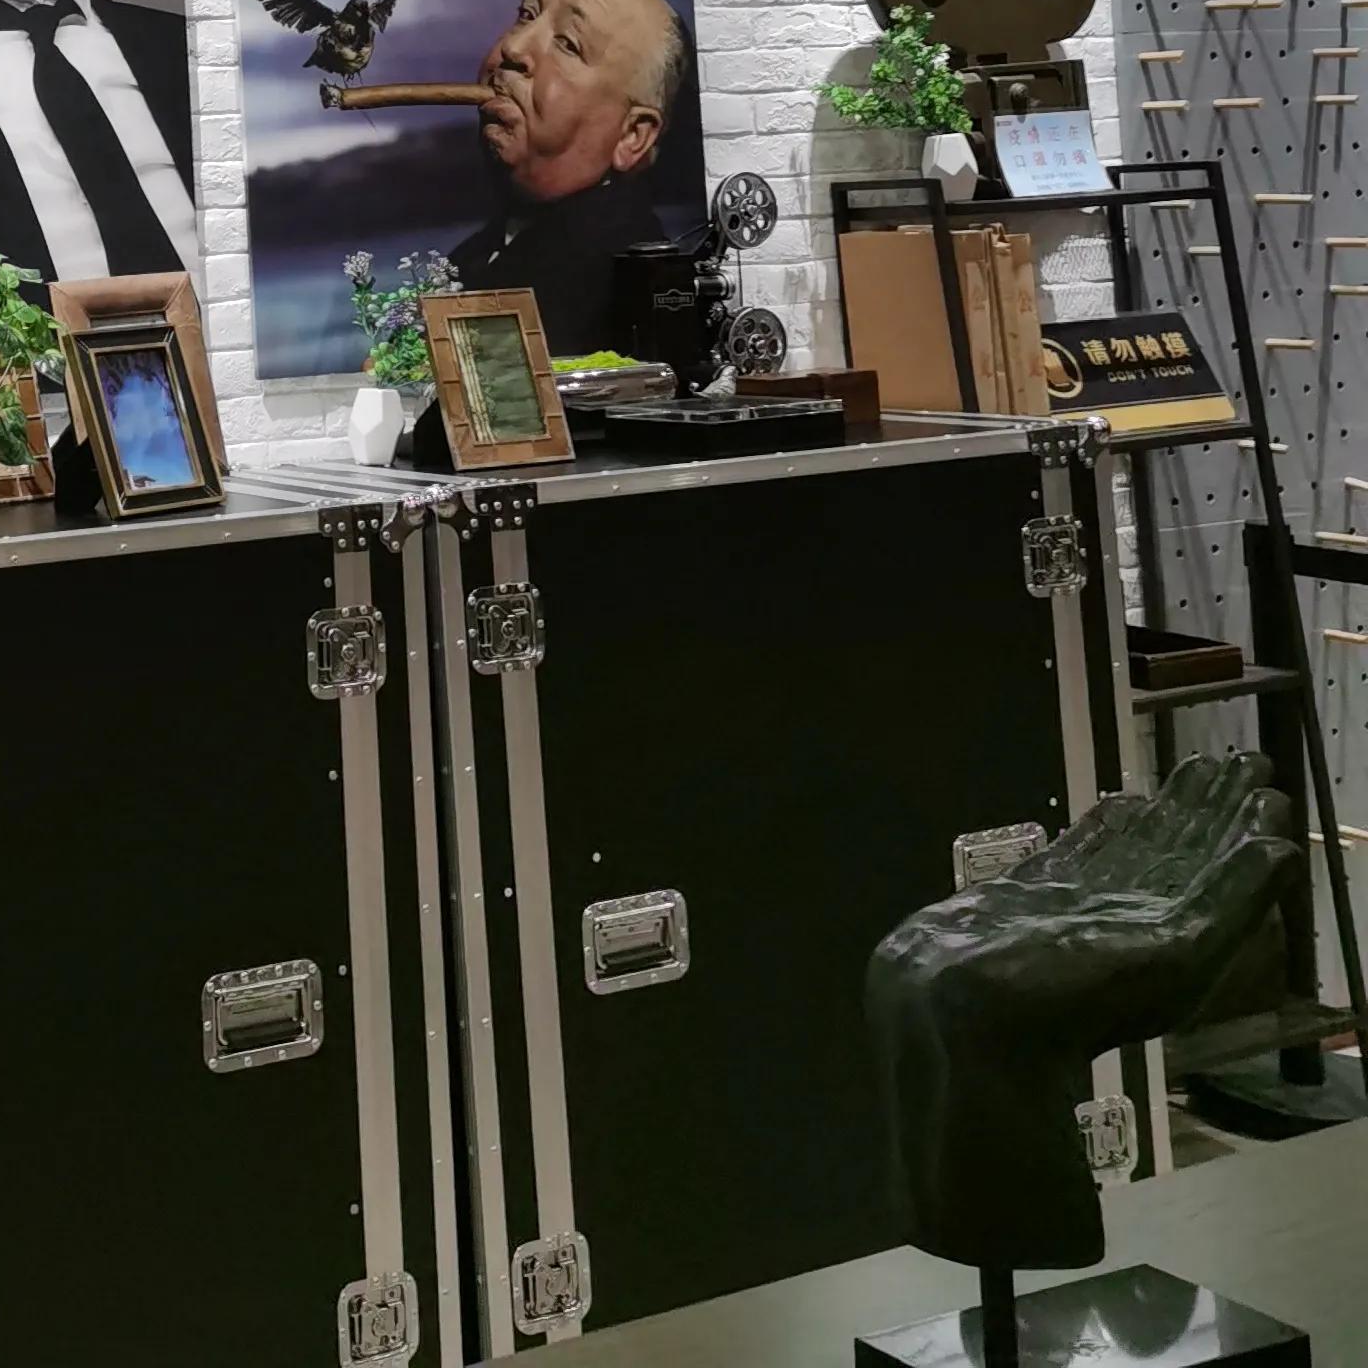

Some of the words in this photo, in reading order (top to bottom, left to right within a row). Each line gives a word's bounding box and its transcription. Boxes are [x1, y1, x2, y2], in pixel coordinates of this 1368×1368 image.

[1081, 332, 1192, 366] 请勿触摸
[1107, 368, 1147, 383] DON'T
[1152, 364, 1195, 379] TOUCH
